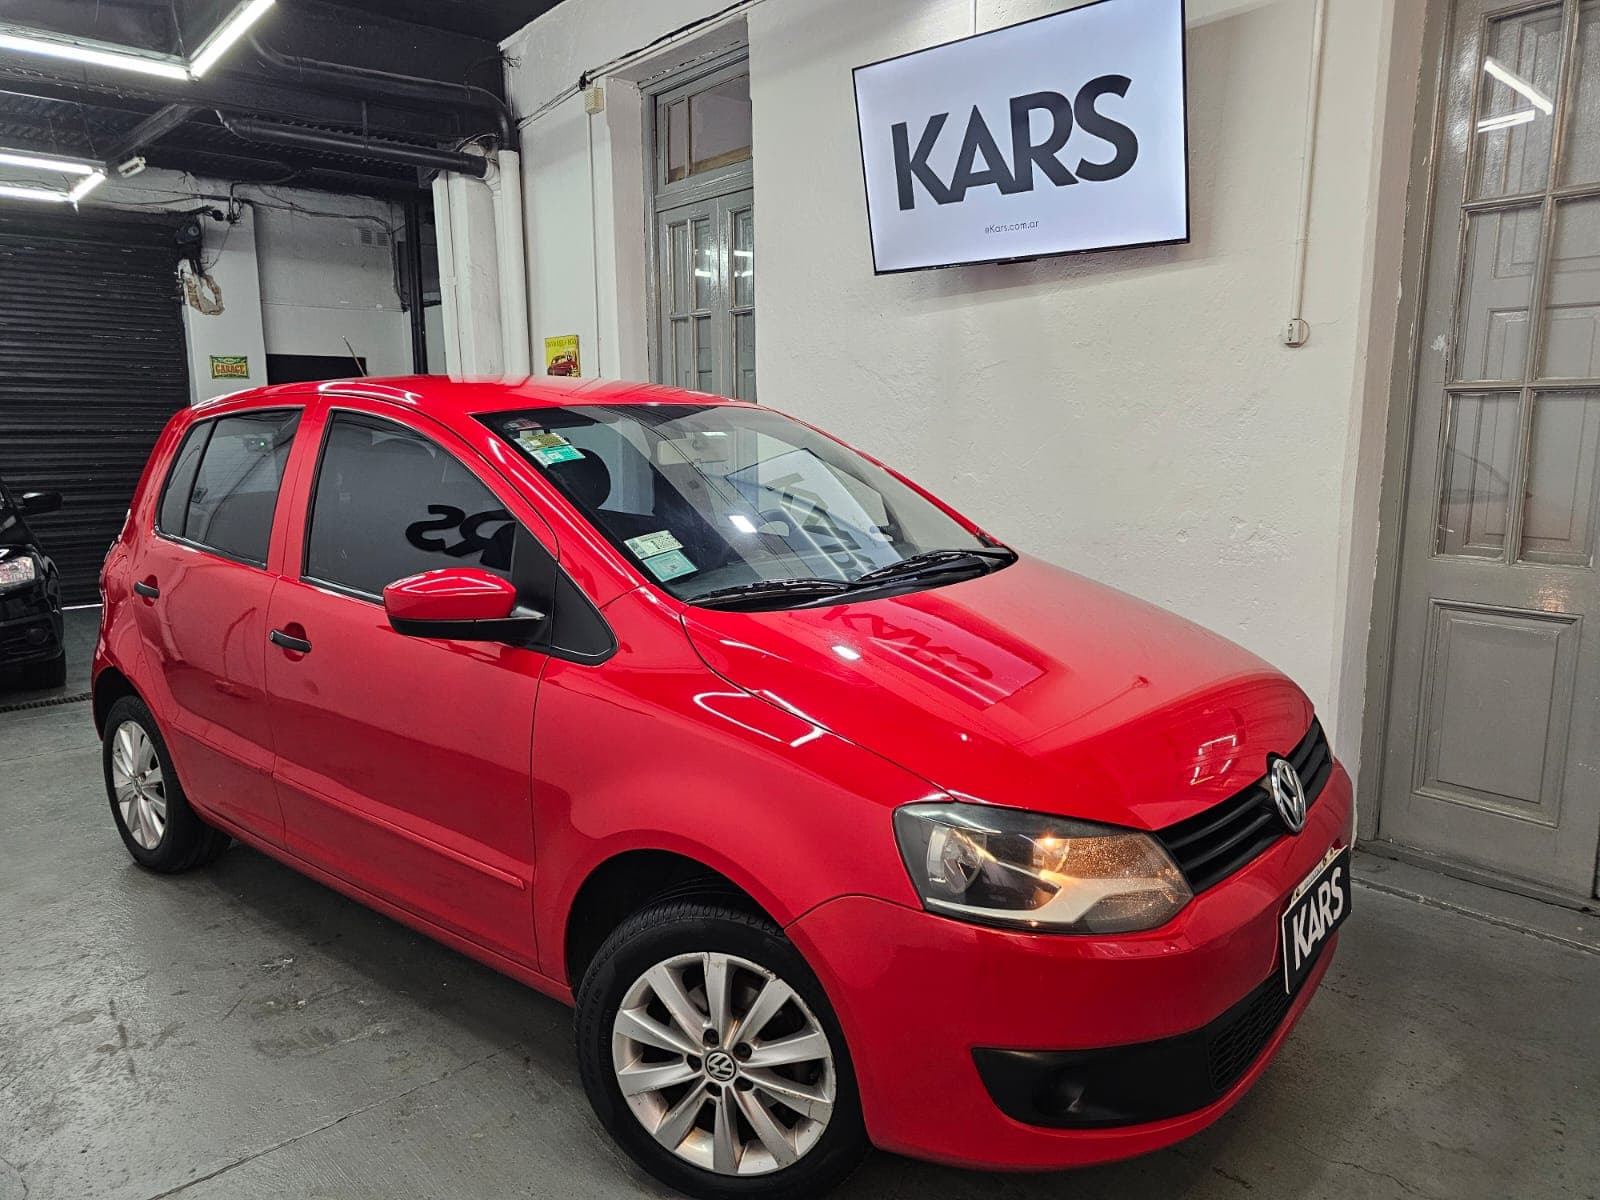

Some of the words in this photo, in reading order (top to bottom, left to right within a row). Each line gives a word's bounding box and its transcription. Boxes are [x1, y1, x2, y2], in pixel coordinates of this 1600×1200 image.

[891, 74, 1139, 211] KARS
[984, 220, 1040, 234] eKars.com.ar
[1292, 866, 1344, 971] KARS
